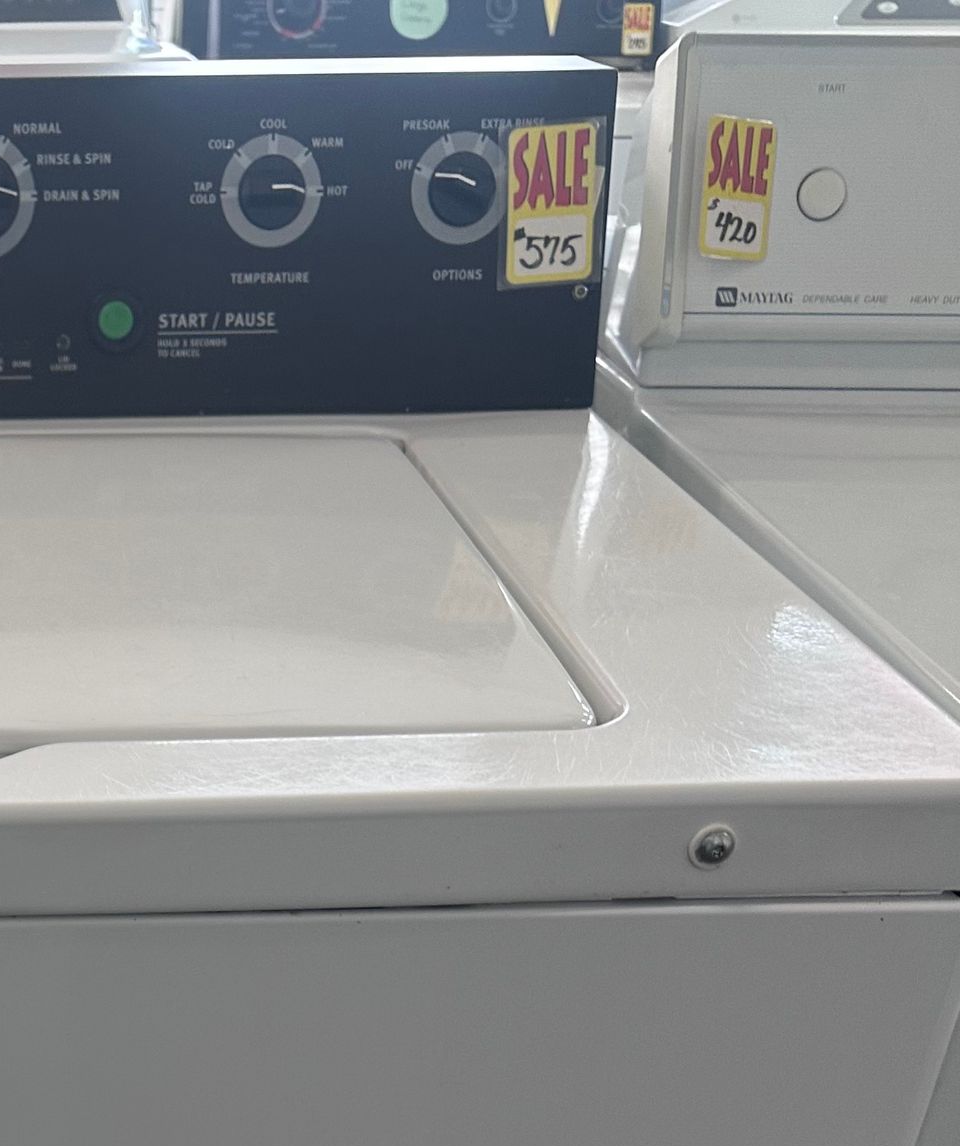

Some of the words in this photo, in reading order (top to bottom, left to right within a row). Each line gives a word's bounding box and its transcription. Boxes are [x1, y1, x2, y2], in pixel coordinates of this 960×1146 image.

[818, 84, 846, 93] START
[13, 123, 62, 135] NORMAL
[260, 118, 287, 129] COOL
[403, 120, 450, 131] PRESOAK
[481, 118, 512, 129] EXTRA
[208, 139, 235, 150] COLD
[312, 137, 344, 148] WARM
[36, 154, 70, 165] RINSE
[72, 154, 82, 165] &
[85, 153, 112, 165] SPIN
[707, 120, 773, 196] SALE
[395, 160, 414, 171] OFF
[513, 127, 590, 210] SALE
[194, 182, 213, 192] TAP
[326, 185, 348, 196] HOT
[43, 190, 78, 201] DRAIN
[81, 190, 90, 201] &
[93, 189, 120, 201] SPIN
[190, 194, 216, 204] COLD
[230, 272, 310, 284] TEMPERATURE
[433, 269, 482, 281] OPTIONS
[741, 292, 793, 304] MAYTAG
[802, 294, 859, 304] DEPENDABLE
[910, 295, 939, 305] HEAVY
[158, 313, 208, 329] START
[212, 312, 220, 331] /
[225, 312, 276, 327] PAUSE
[190, 337, 227, 347] SECONDS
